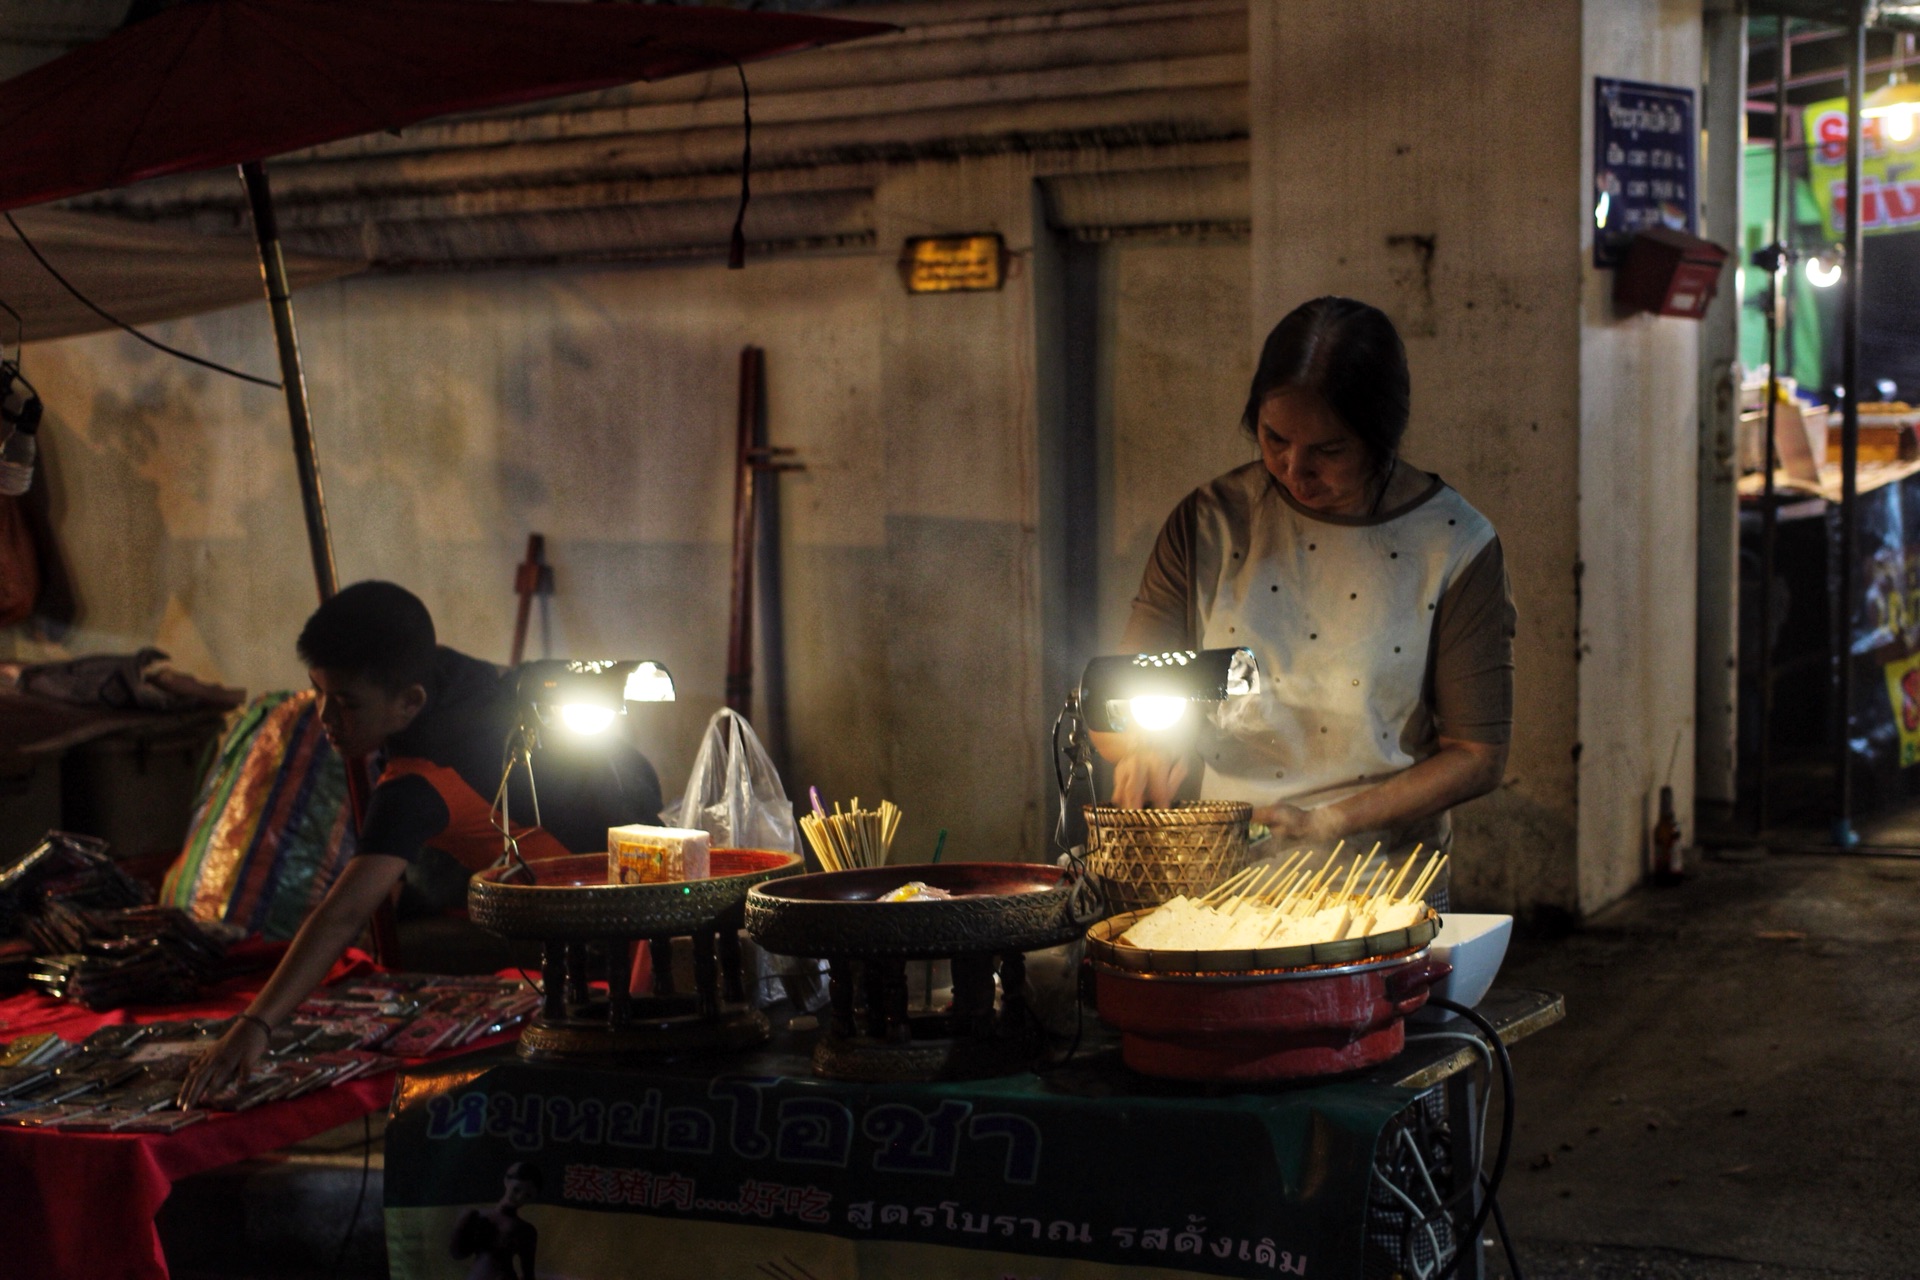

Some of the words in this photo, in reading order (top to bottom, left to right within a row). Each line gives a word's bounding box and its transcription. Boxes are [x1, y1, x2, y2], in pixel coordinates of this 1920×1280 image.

[847, 1200, 1093, 1244] สูตรโบราณ
[1111, 1213, 1308, 1276] รสดั้งเดิม
